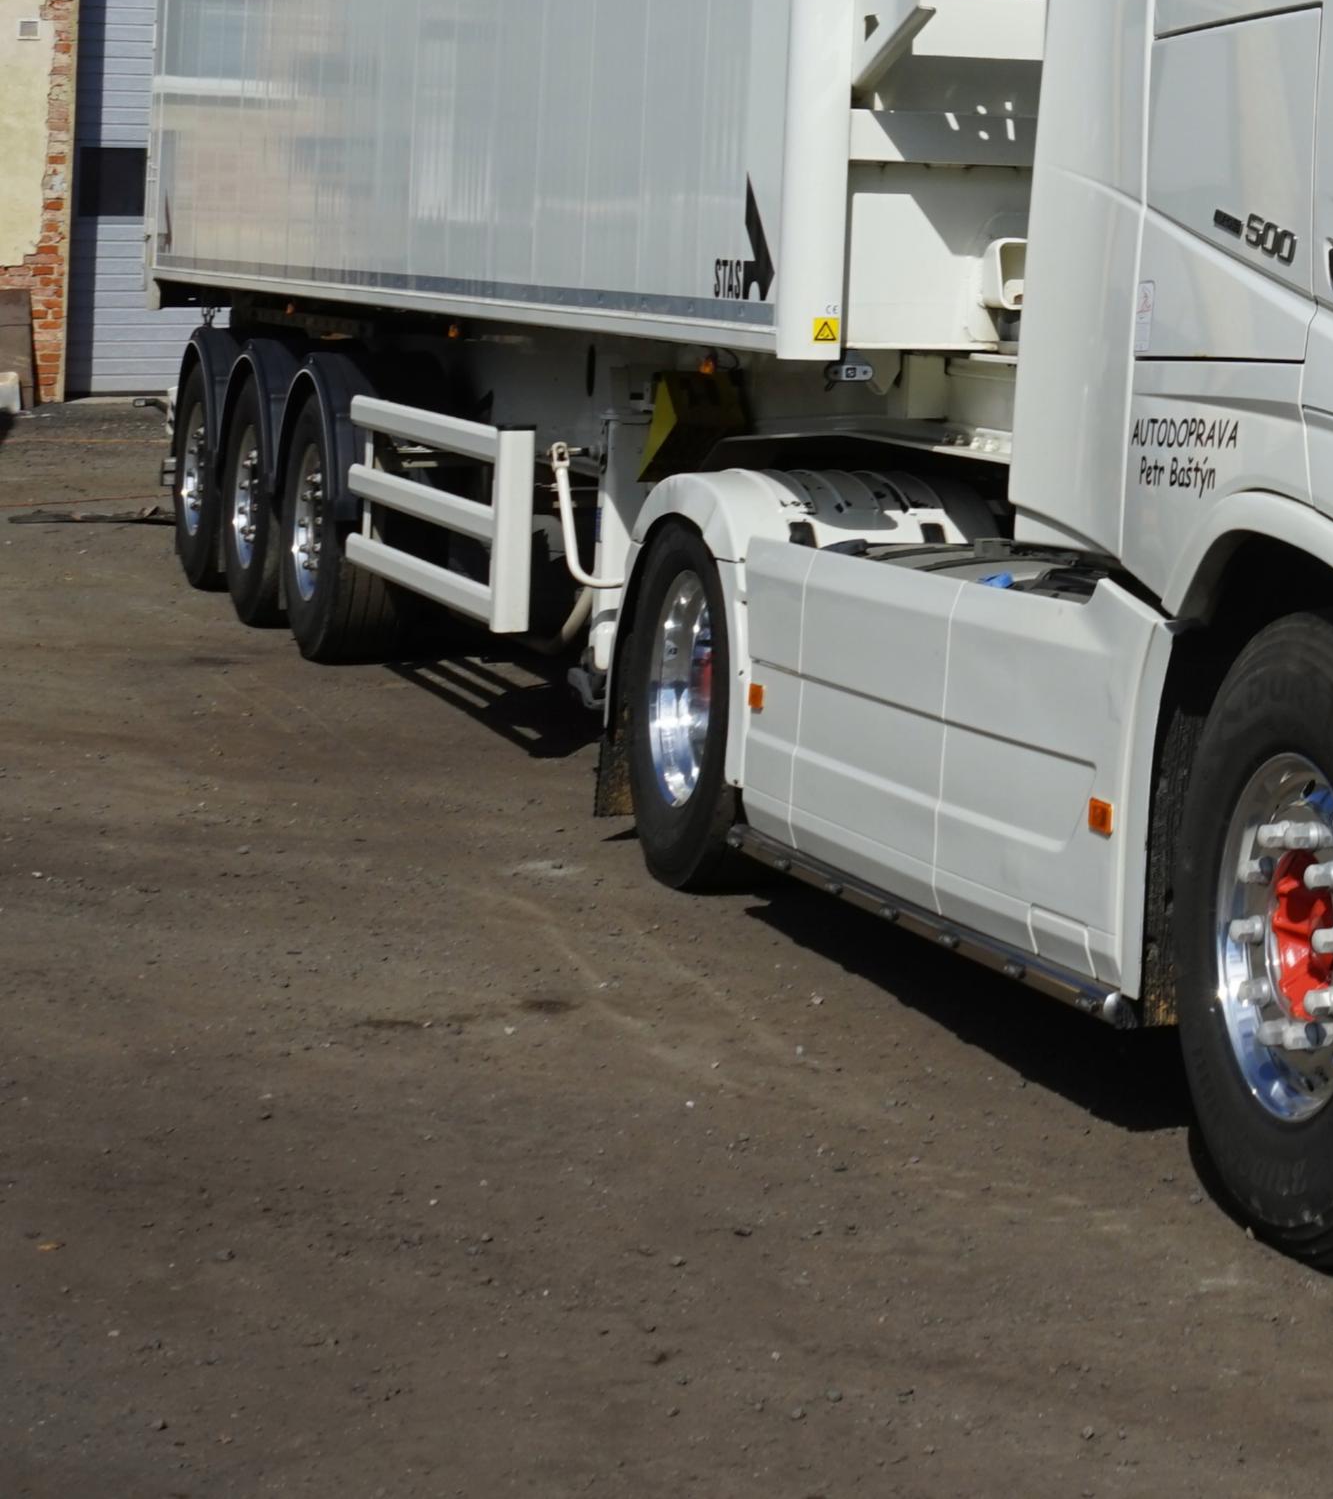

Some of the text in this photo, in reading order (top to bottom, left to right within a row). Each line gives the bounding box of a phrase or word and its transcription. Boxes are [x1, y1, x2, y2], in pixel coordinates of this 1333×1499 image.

[1245, 213, 1297, 267] 500
[714, 258, 742, 299] STAS
[1130, 417, 1239, 449] AUTODOPRAVA
[1139, 455, 1216, 499] Petr Baštýn
